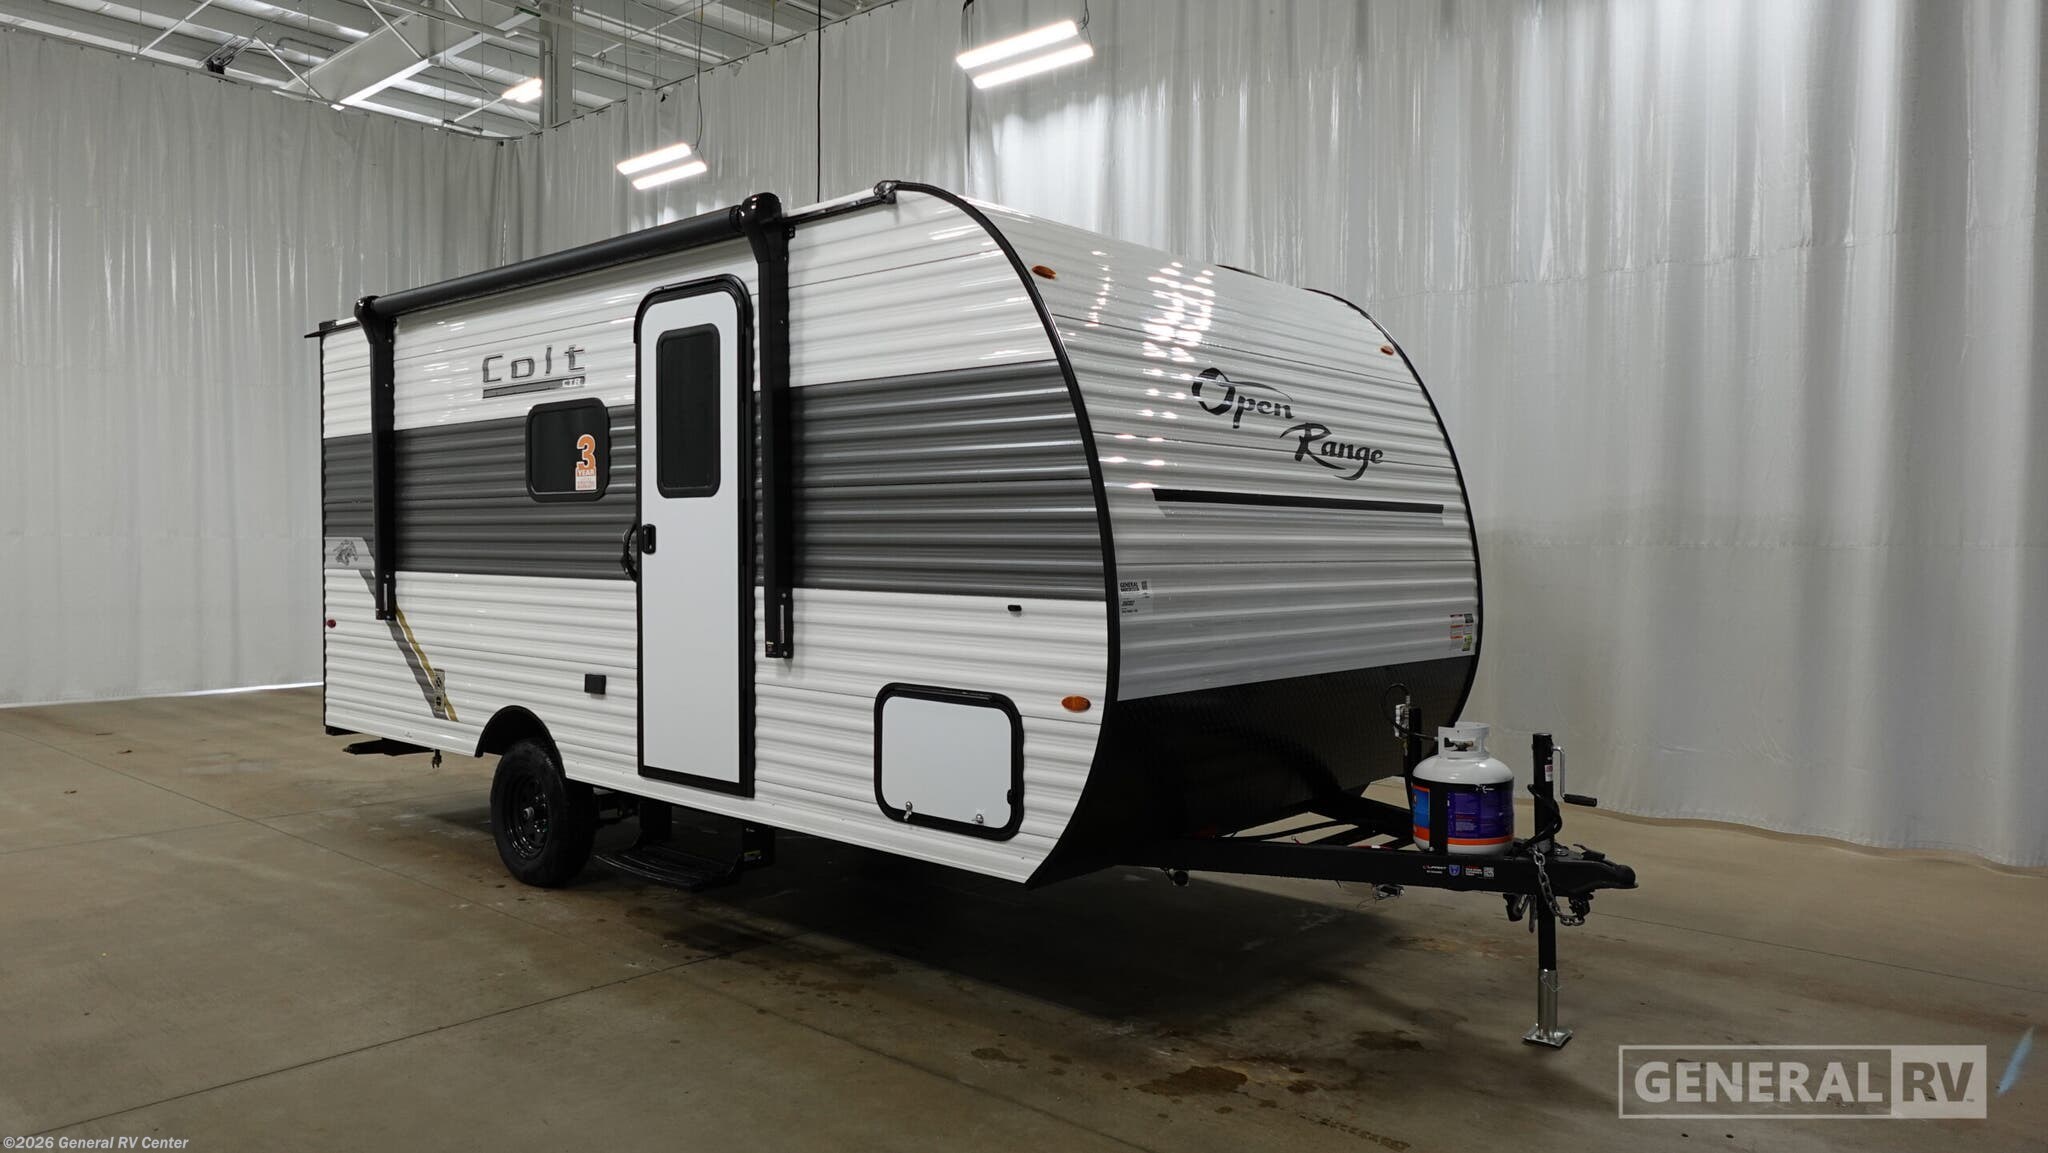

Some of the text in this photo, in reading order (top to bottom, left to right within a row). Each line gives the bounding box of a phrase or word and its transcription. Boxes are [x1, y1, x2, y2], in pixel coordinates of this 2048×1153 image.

[482, 345, 585, 383] Colt
[1192, 368, 1295, 429] Open
[576, 434, 596, 470] 3
[1280, 422, 1384, 481] Range
